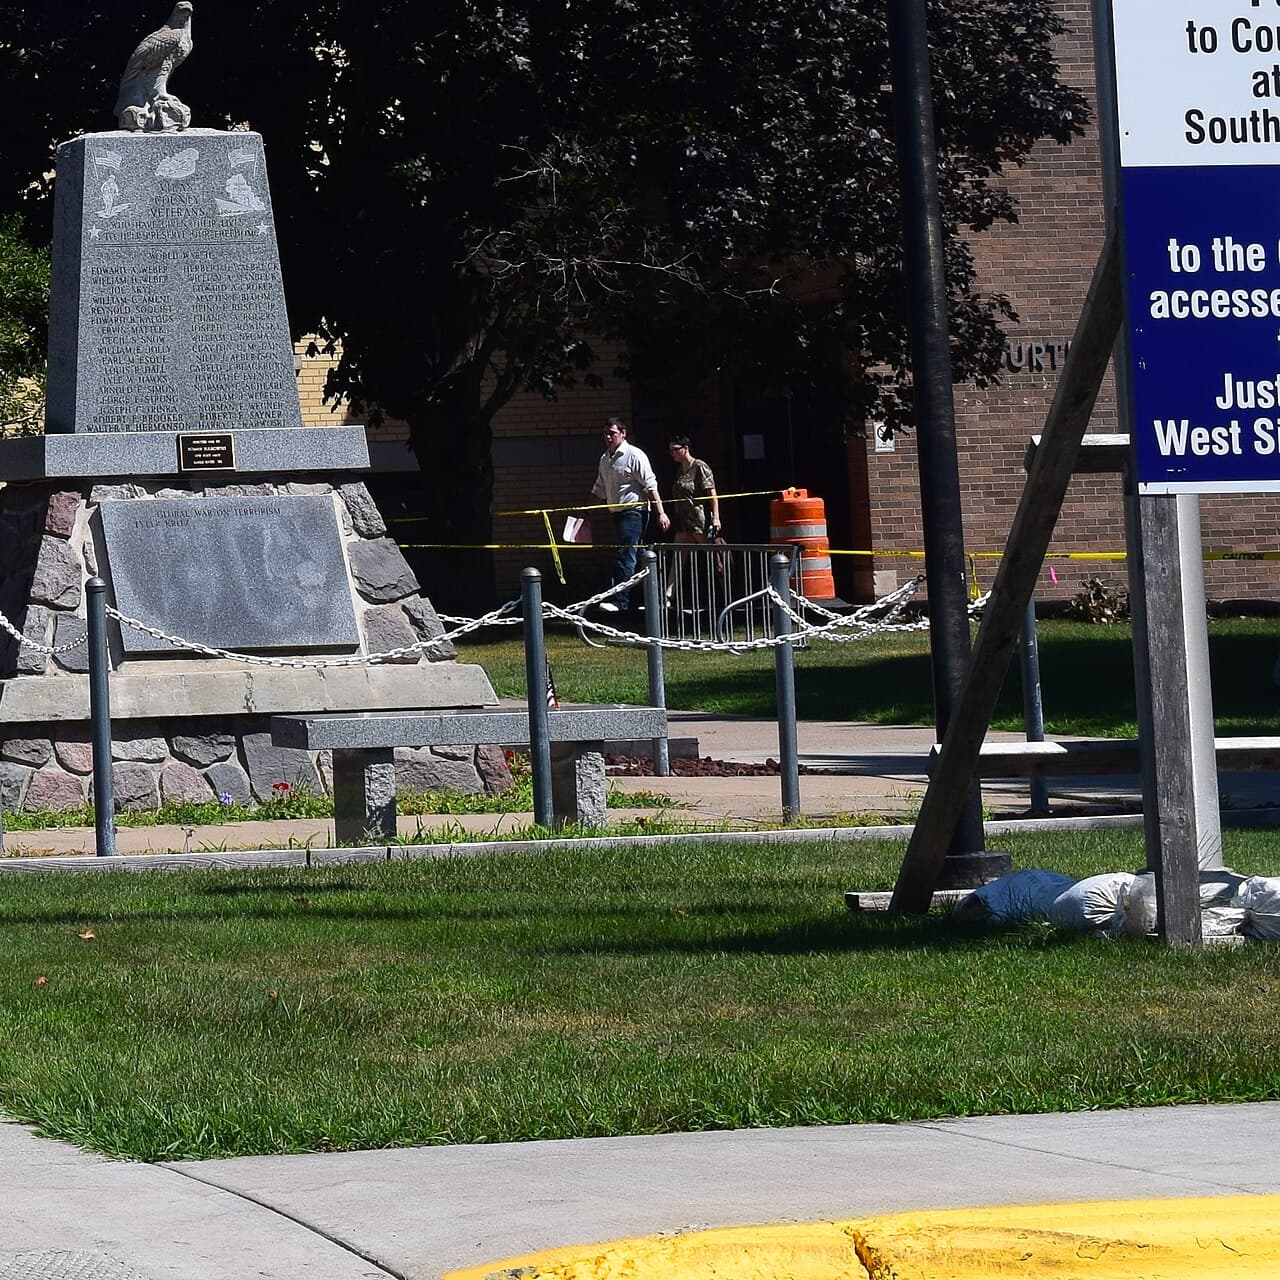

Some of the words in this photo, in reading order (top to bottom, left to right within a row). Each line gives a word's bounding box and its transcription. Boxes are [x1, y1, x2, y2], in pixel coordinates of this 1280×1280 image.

[1186, 21, 1217, 53] to
[1231, 17, 1280, 53] Co
[154, 195, 200, 206] COUNTY
[149, 207, 206, 218] VETERANS
[135, 221, 157, 229] HAVE
[149, 252, 179, 260] WORLD
[1168, 238, 1200, 272] to
[1212, 236, 1266, 271] the
[1153, 420, 1242, 456] West
[194, 508, 212, 518] WAR
[233, 507, 281, 517] TERRORISM
